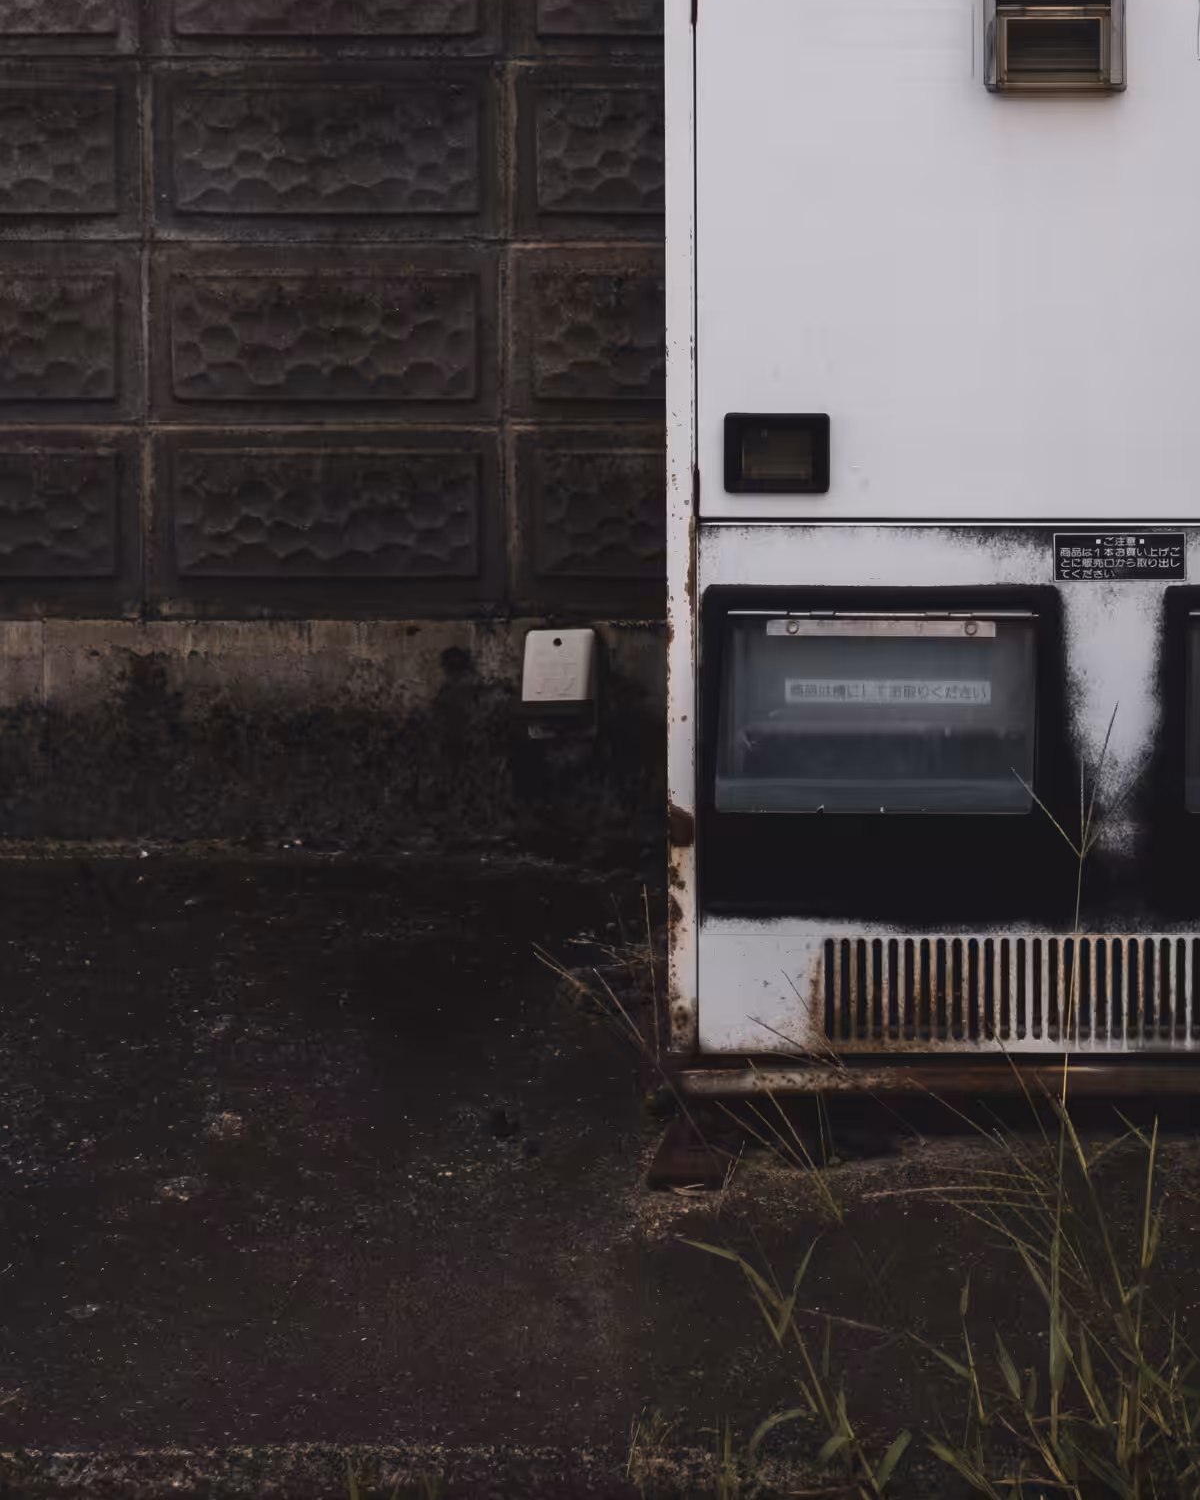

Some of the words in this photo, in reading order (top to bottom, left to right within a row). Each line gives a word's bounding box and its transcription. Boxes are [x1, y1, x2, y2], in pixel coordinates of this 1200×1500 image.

[1060, 569, 1116, 579] てください
